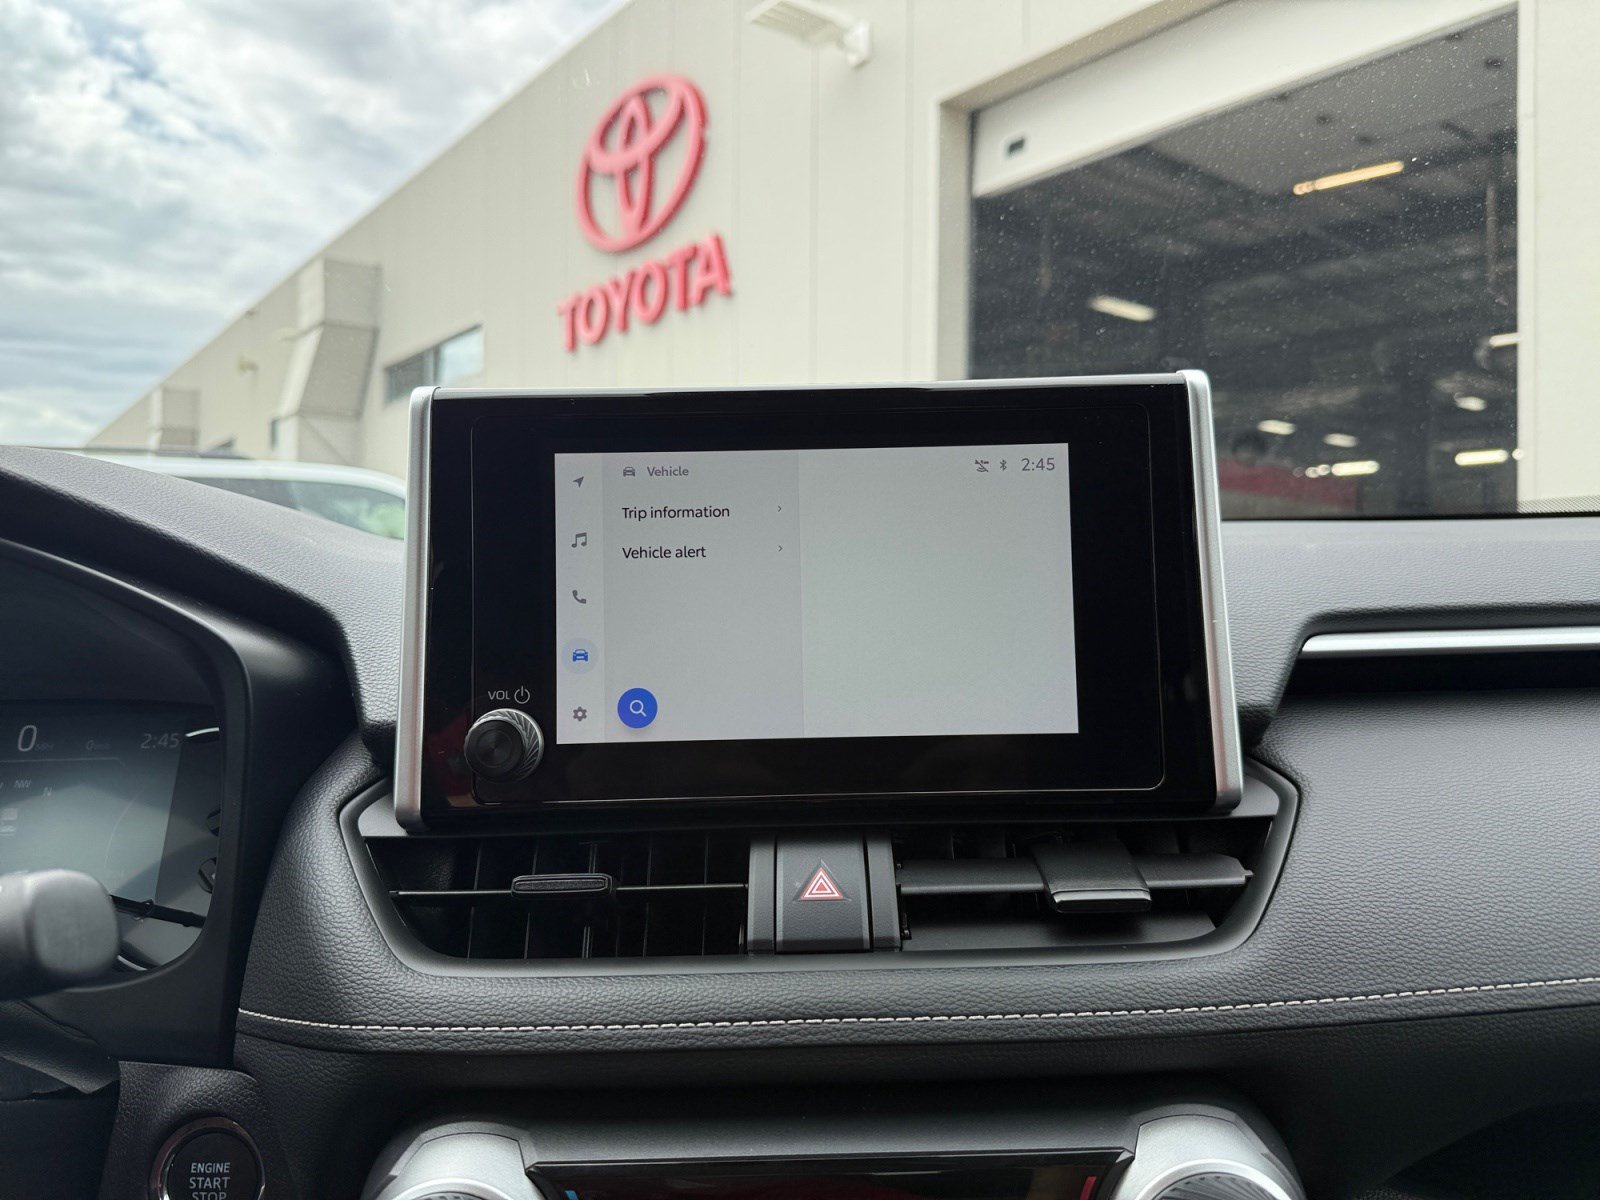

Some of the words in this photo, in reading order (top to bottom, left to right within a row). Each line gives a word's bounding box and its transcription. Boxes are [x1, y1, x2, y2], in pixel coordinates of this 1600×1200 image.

[557, 232, 733, 354] TOYOTA
[1021, 457, 1055, 471] 2:45
[647, 466, 689, 477] Vehicle
[622, 507, 647, 521] Trip
[650, 505, 730, 518] information
[622, 546, 672, 559] Vehicle
[675, 546, 706, 558] alert
[488, 690, 510, 700] VOL
[17, 724, 38, 752] 0
[140, 733, 180, 750] 2:45
[190, 1162, 230, 1173] ENGINE
[189, 1176, 231, 1190] START
[192, 1191, 227, 1200] STOP
